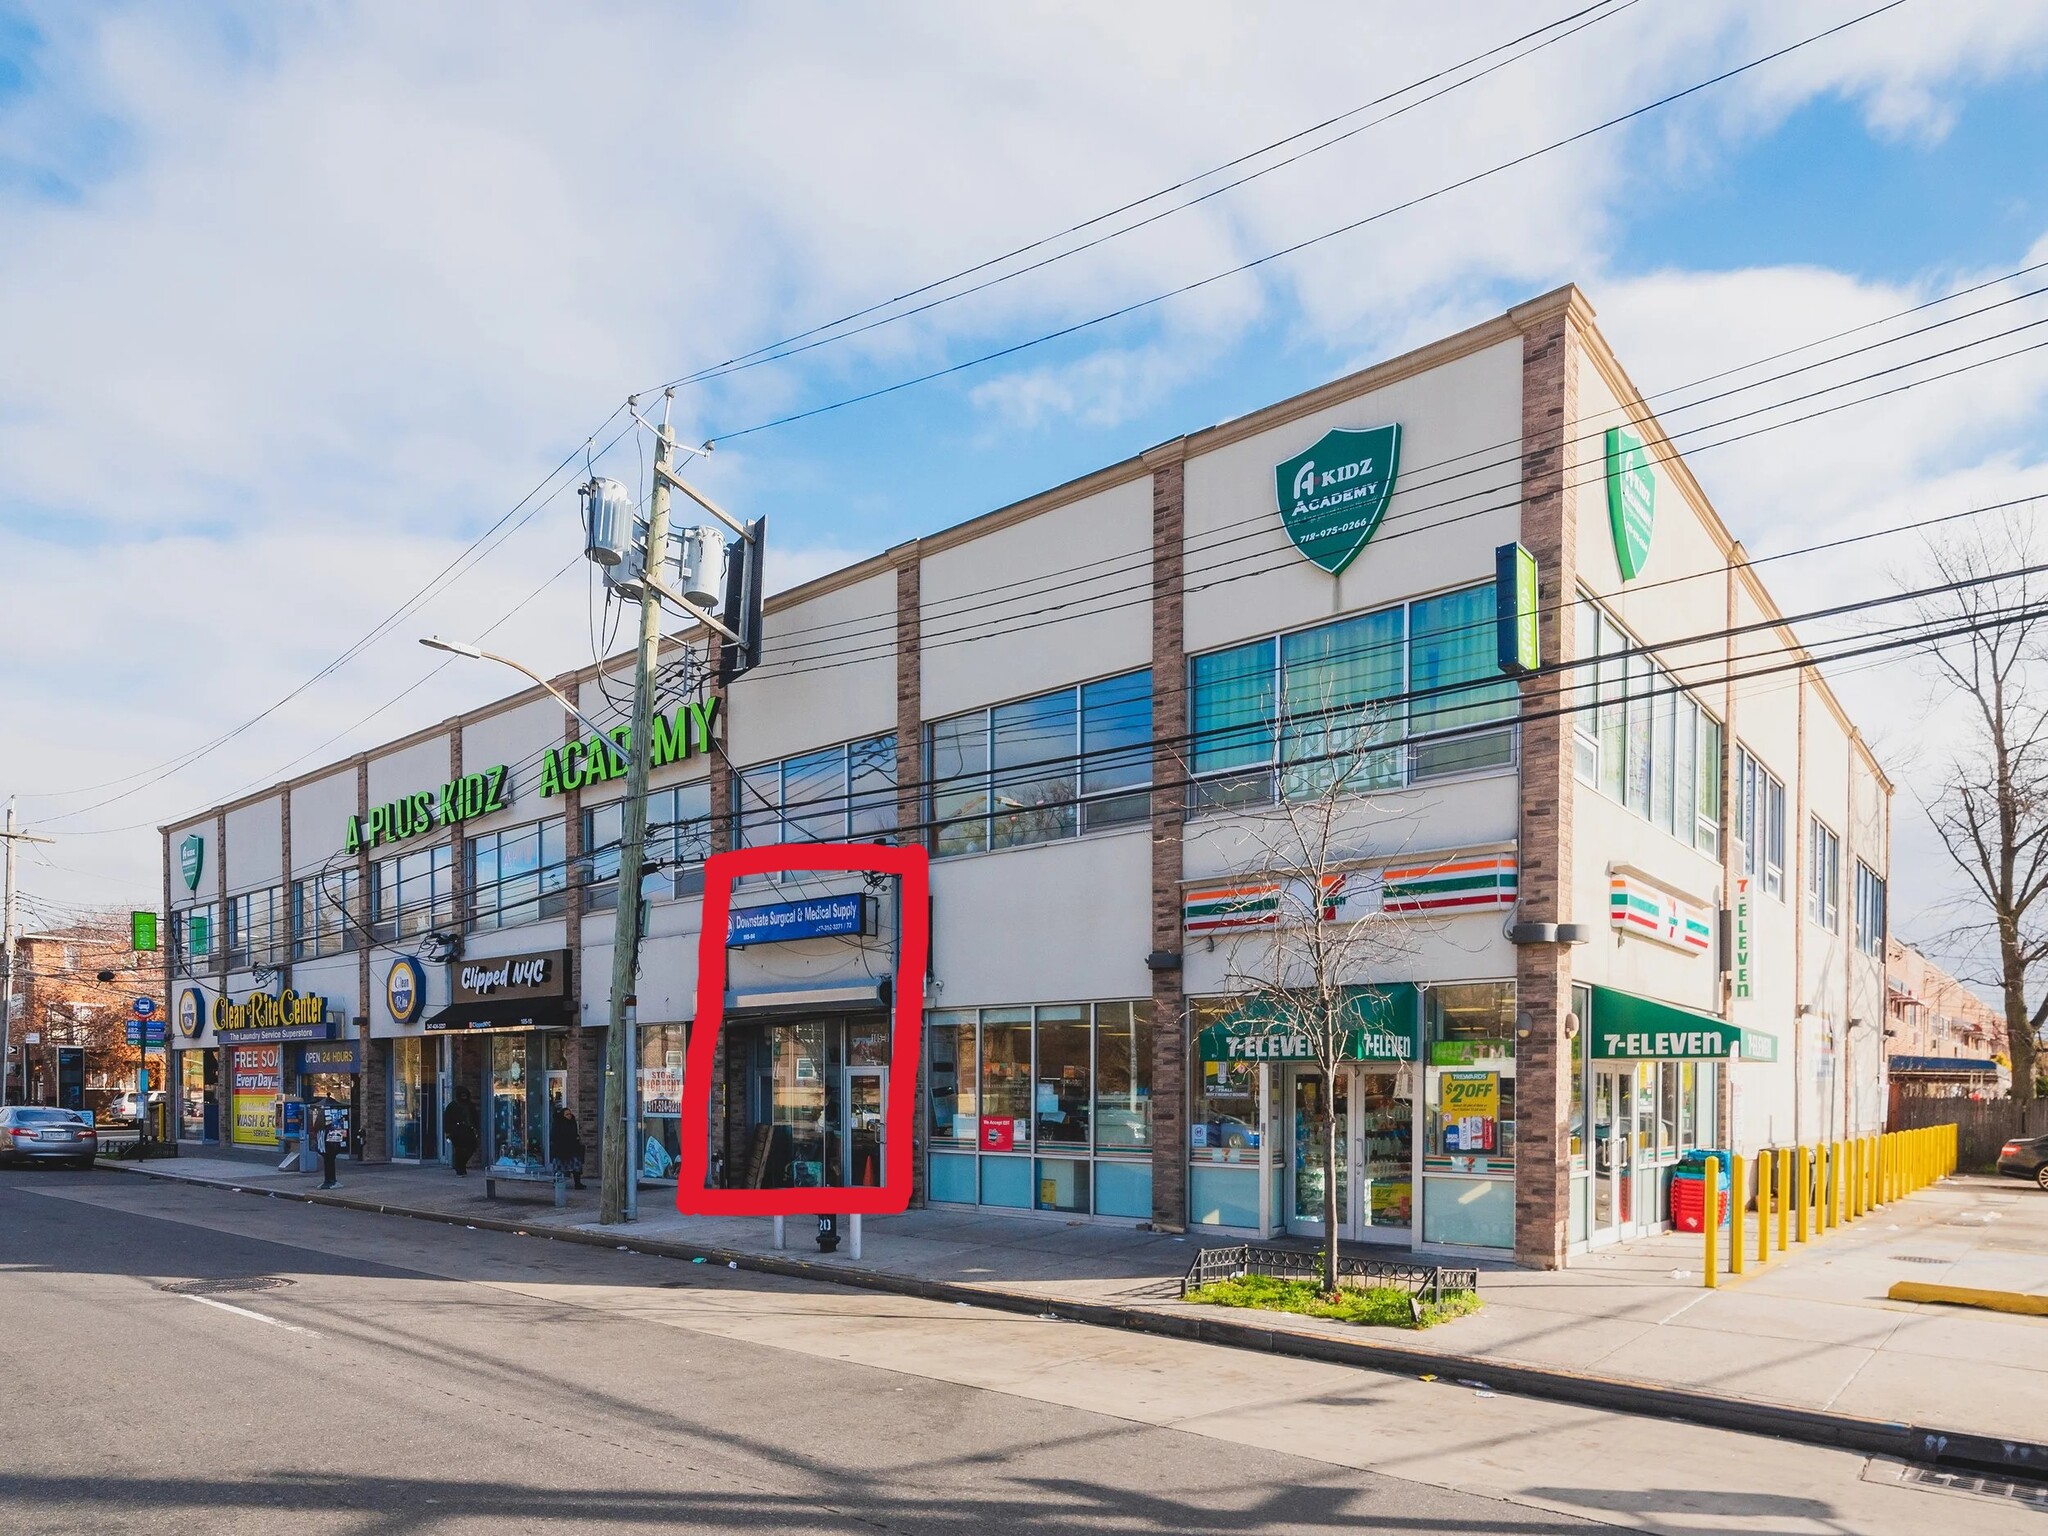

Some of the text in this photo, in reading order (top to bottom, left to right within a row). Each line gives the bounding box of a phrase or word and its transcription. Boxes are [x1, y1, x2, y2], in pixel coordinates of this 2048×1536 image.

[1321, 457, 1373, 487] KIDZ
[1291, 484, 1377, 517] ACADEMY
[1300, 517, 1367, 543] 718-975-0266
[345, 696, 721, 855] A PLUS KIDZ ACADMY
[736, 901, 857, 930] Downstate Surgical & Medical Supply
[461, 958, 545, 995] Clipped NYC
[212, 988, 323, 1031] Clean Rite Center
[229, 1029, 313, 1043] The Laundry Service Superstore
[1604, 1031, 1723, 1056] 7-ELEVEn
[234, 1050, 259, 1068] FREE
[305, 1050, 353, 1063] OPEN 24 HOURS
[236, 1072, 257, 1089] Every
[258, 1071, 273, 1089] Day
[1465, 1083, 1494, 1098] OFF
[237, 1114, 258, 1128] WASH
[259, 1114, 265, 1128] &
